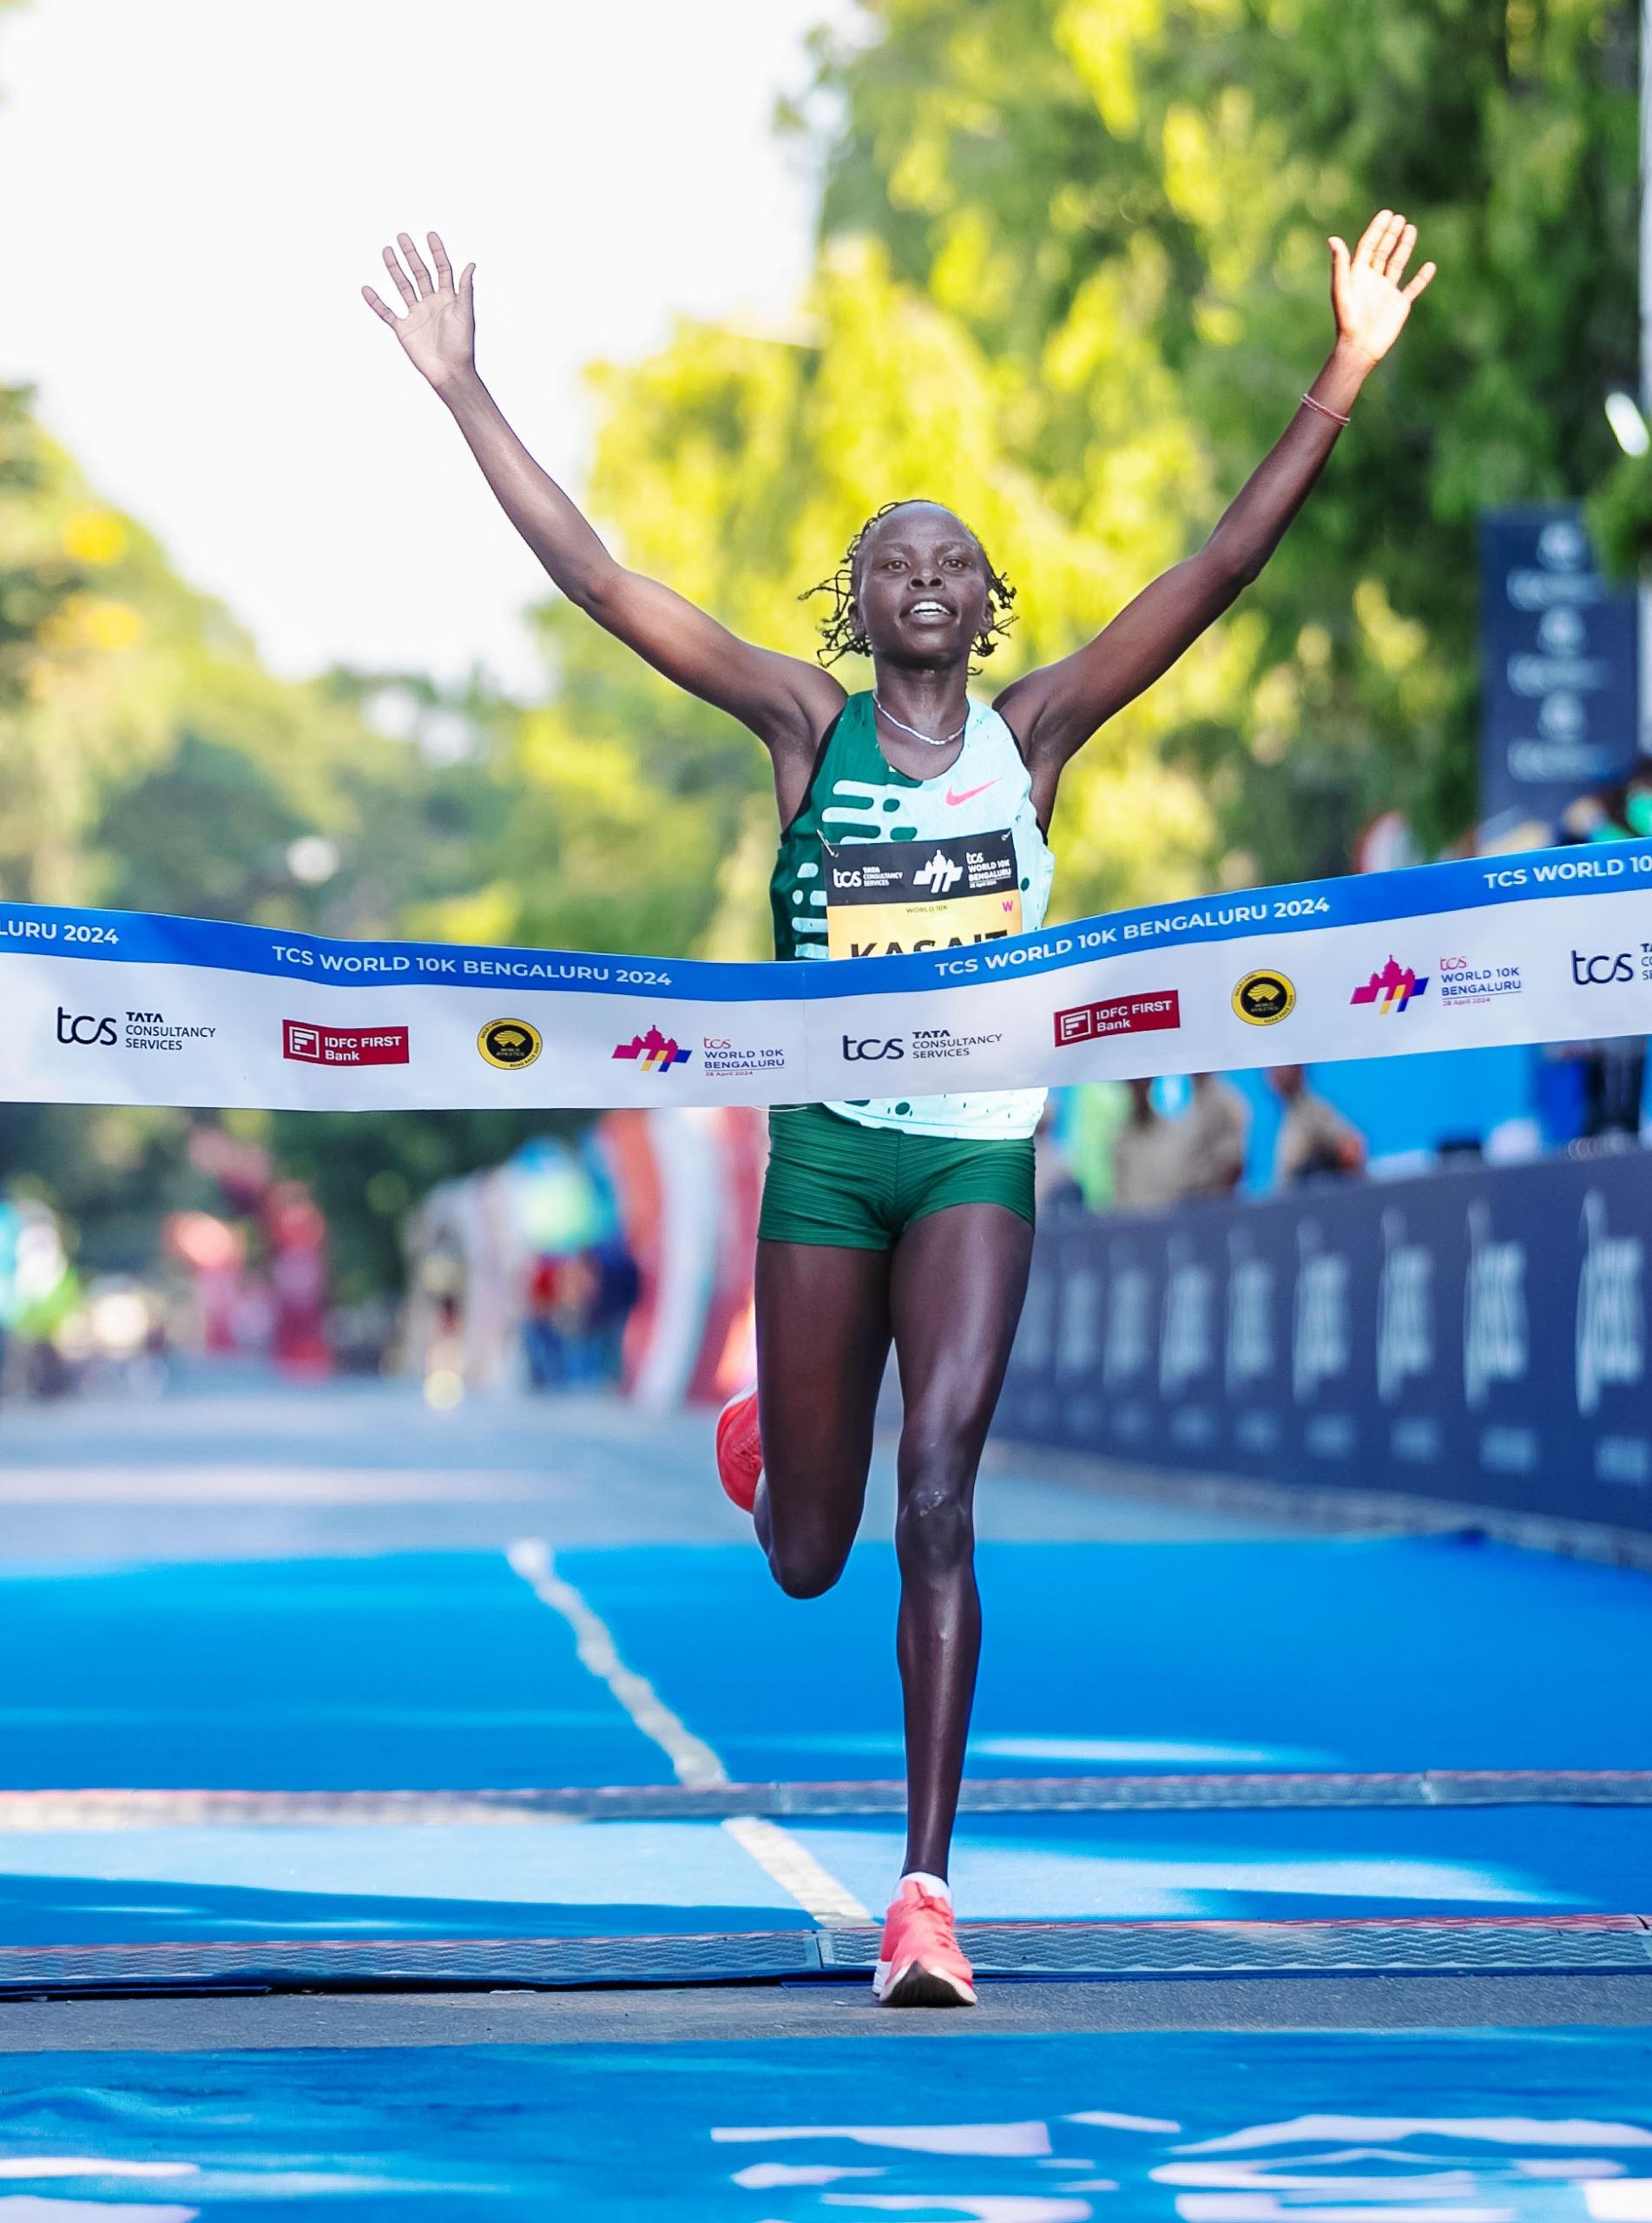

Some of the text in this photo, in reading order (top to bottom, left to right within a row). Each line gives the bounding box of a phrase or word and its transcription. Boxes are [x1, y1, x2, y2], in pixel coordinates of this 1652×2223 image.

[966, 852, 984, 865] tcs
[968, 859, 1010, 874] WORLD 10K
[1483, 868, 1527, 889] TCS
[1533, 859, 1624, 882] WORLD
[833, 867, 862, 887] tcs
[1002, 900, 1014, 913] W
[63, 924, 120, 945] 2024
[935, 897, 1330, 977] TCS WORLD 10K BENGALURU 2024
[272, 945, 672, 986] TCS WORLD 10K BENGALURU 2024
[1439, 956, 1467, 971] tcs
[1570, 950, 1634, 986] tcs
[1441, 966, 1520, 983] WORLD 10K
[1441, 980, 1522, 996] BENGALURU
[125, 1011, 163, 1023] TATA
[1096, 999, 1173, 1020] IDFC FIRST
[56, 1006, 118, 1046] tcs
[125, 1025, 216, 1038] CONSULTANCY
[1096, 1018, 1131, 1032] Bank
[912, 1029, 951, 1039] TATA
[912, 1033, 1003, 1049] CONSULTANCY
[125, 1038, 183, 1051] SERVICES
[324, 1036, 402, 1048] IDFC FIRST
[703, 1035, 732, 1049] tcs
[842, 1034, 904, 1061] tcs
[325, 1049, 360, 1060] Bank
[912, 1046, 970, 1059] SERVICES
[704, 1059, 785, 1068] BENGALURU
